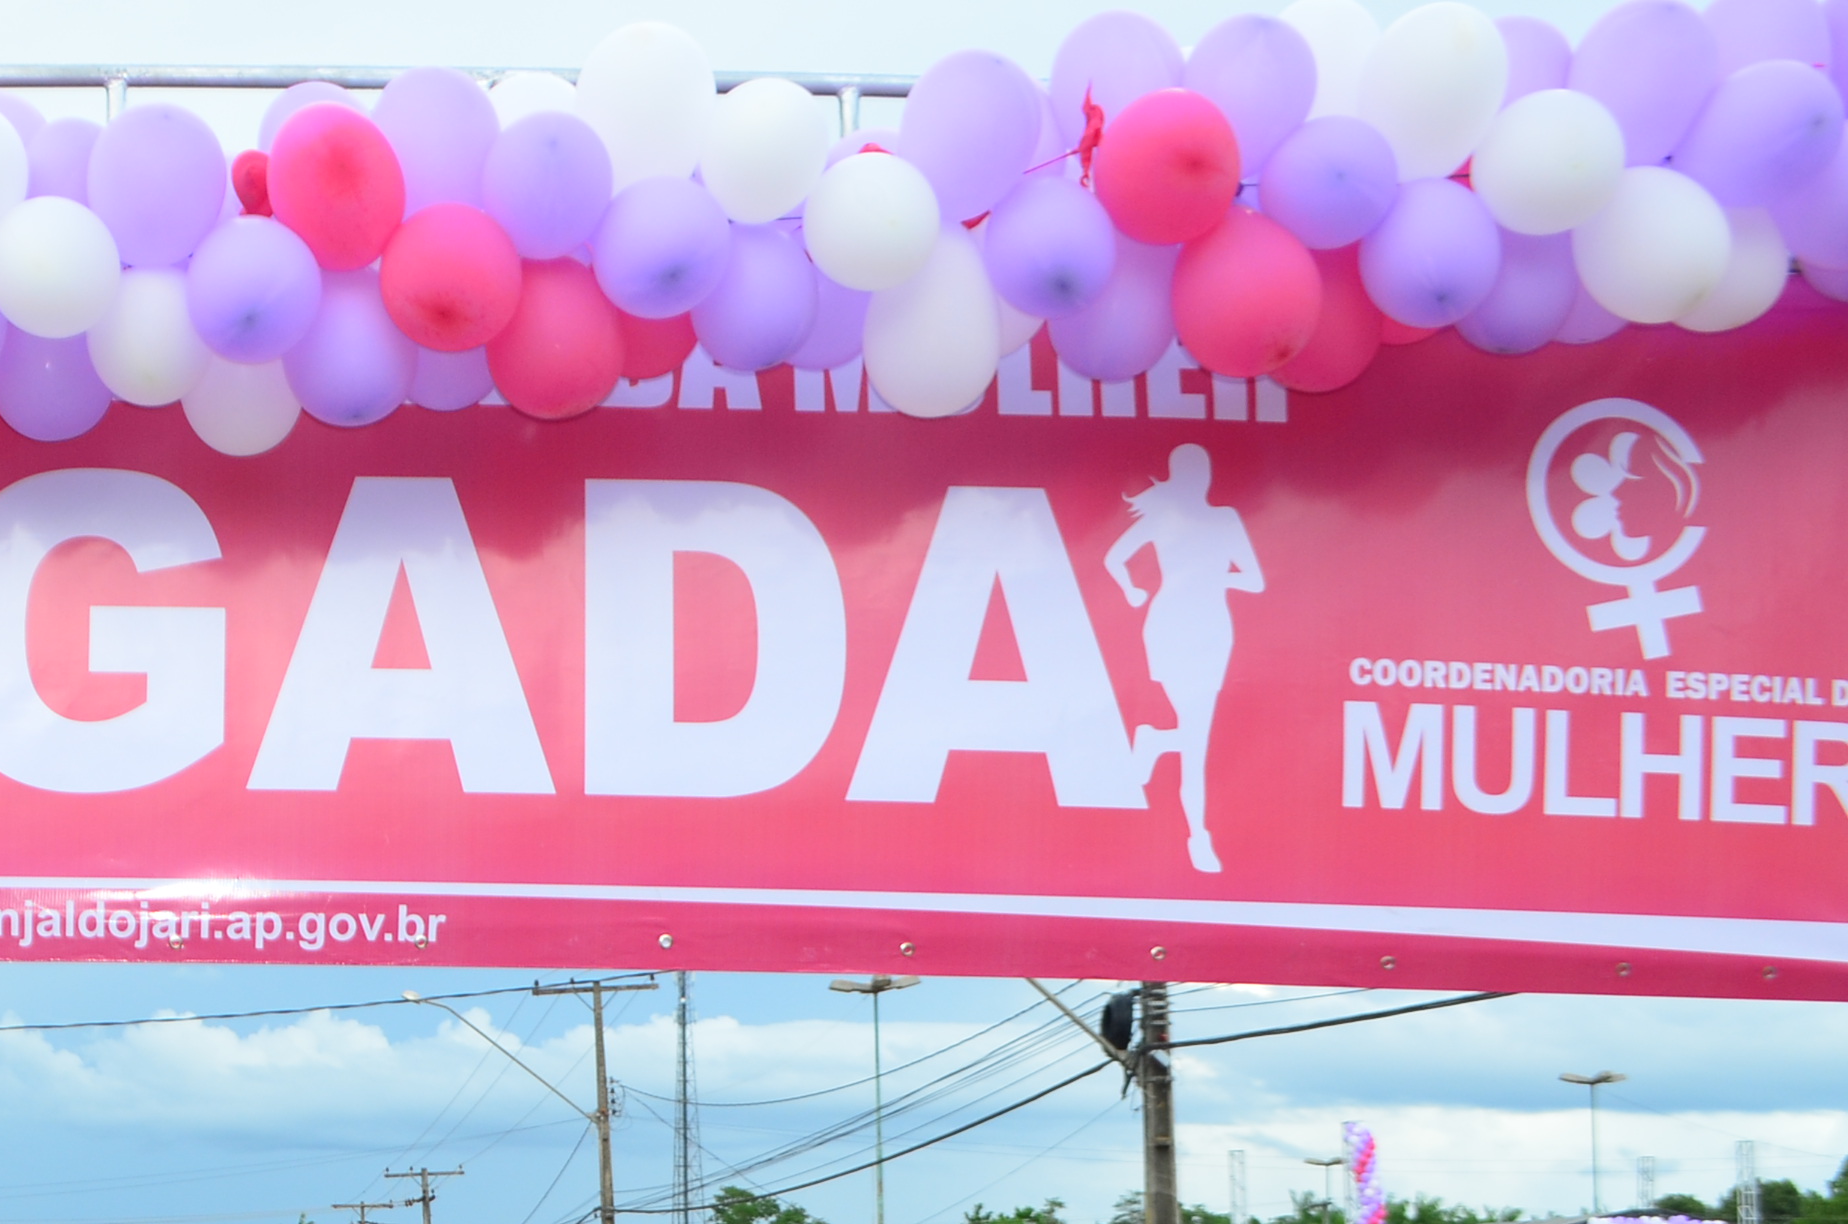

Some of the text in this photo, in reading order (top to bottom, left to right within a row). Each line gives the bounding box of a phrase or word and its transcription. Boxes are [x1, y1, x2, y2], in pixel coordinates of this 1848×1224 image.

[1350, 657, 1650, 697] COORDENADORIA
[1665, 670, 1825, 707] ESPECIAL
[1341, 700, 1848, 826] MULHER
